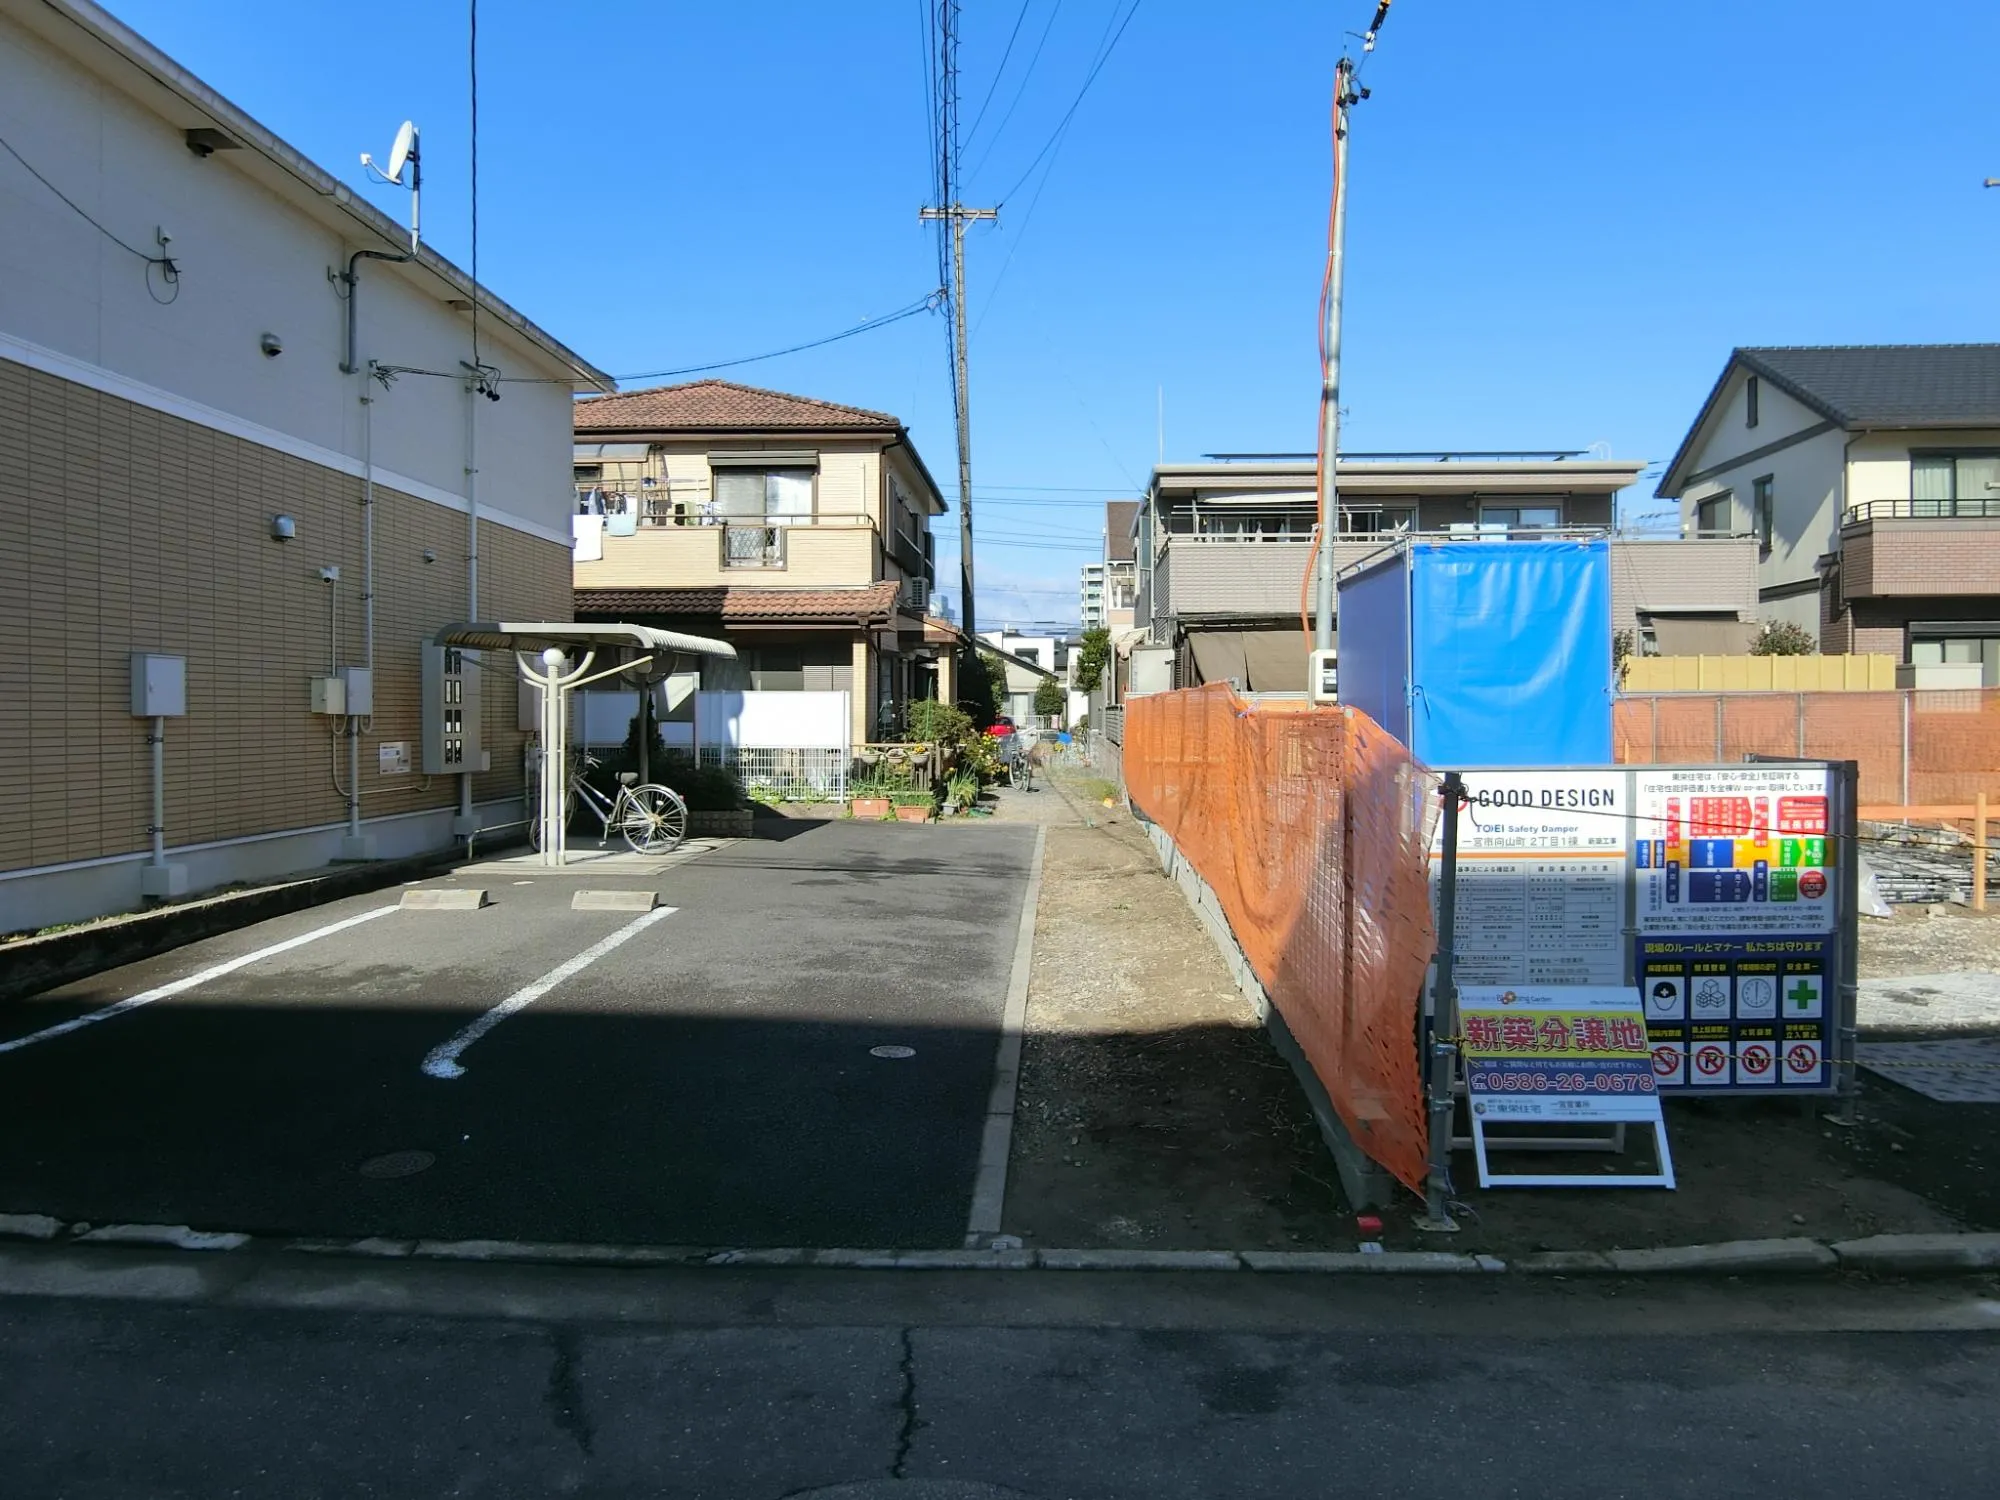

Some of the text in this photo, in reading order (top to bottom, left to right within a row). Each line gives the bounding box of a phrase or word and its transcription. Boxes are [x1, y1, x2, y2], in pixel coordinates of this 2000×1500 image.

[1478, 788, 1615, 807] GOOD DESIGN
[1508, 825, 1538, 834] Safety
[1541, 824, 1579, 834] Damper
[1461, 837, 1526, 848] 一宮市向山町
[1745, 941, 1823, 953] 私たちは守ります
[1464, 1015, 1648, 1052] 新築分譲地
[1487, 1072, 1656, 1092] 0586-26-0678
